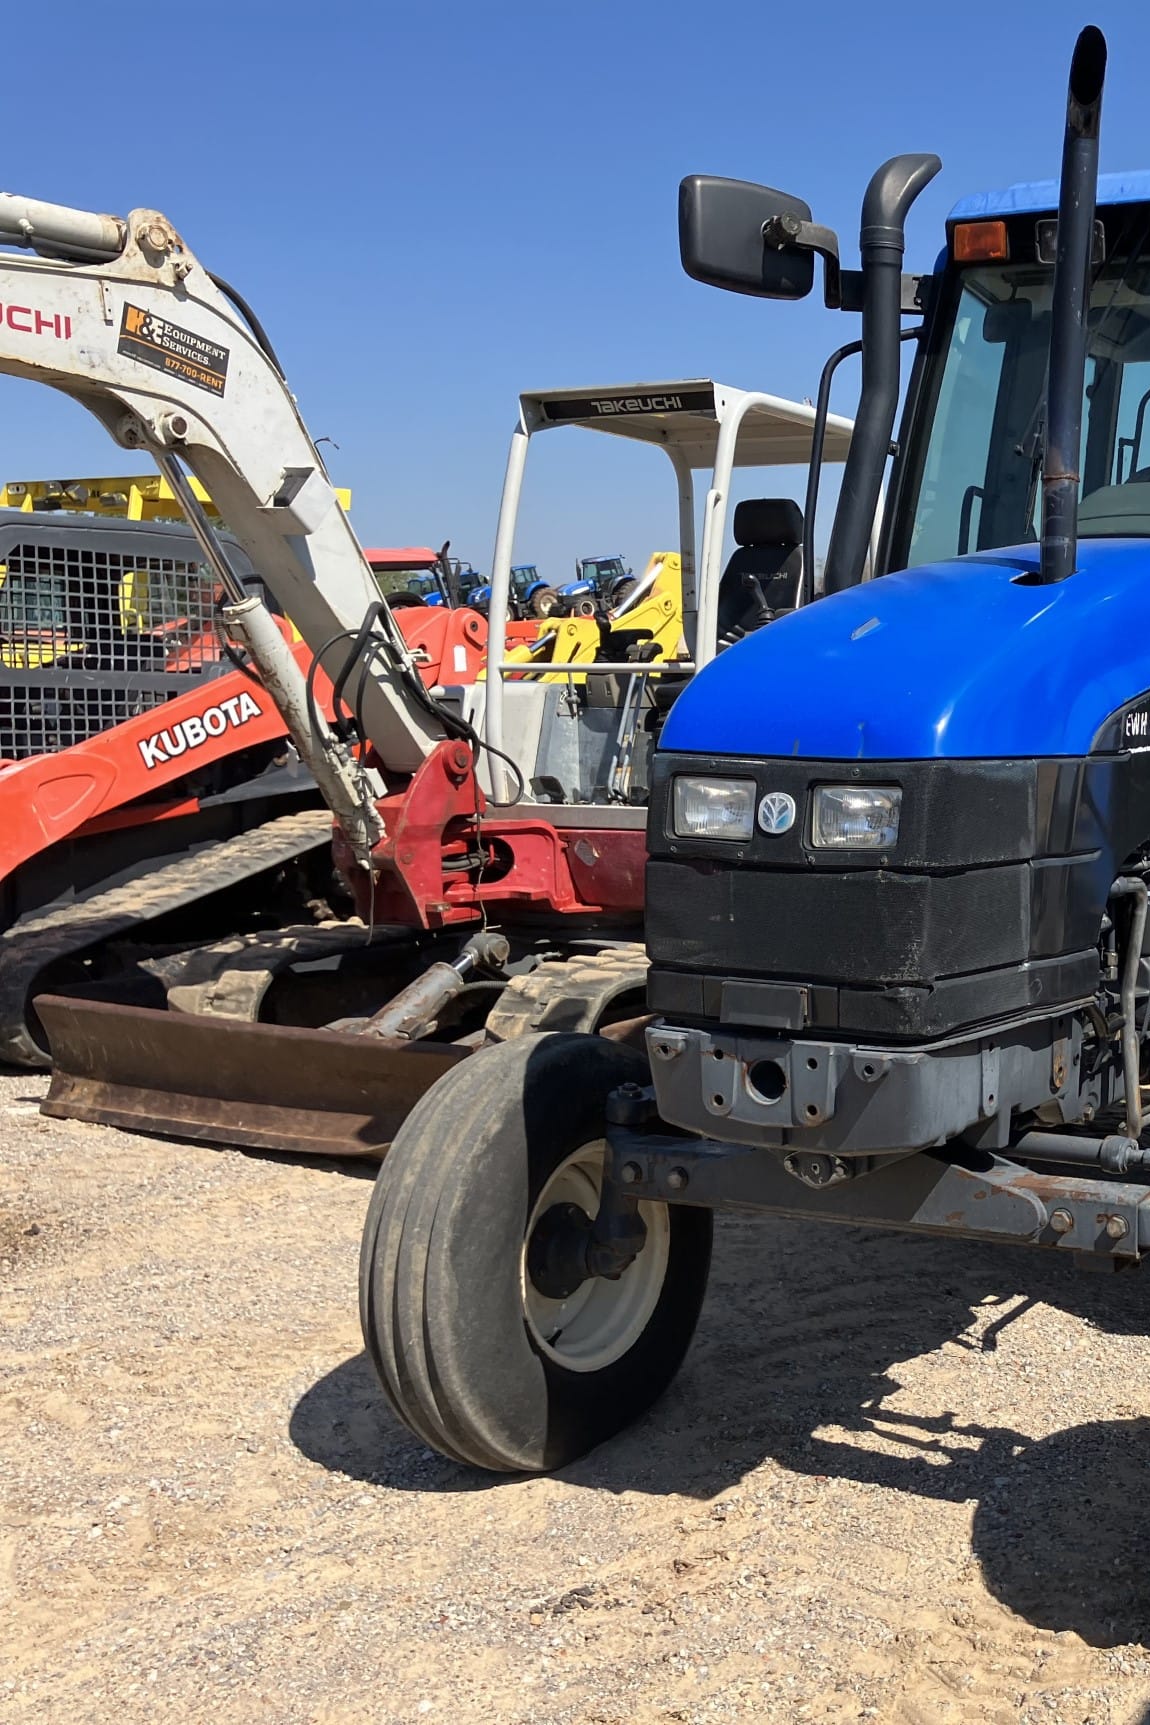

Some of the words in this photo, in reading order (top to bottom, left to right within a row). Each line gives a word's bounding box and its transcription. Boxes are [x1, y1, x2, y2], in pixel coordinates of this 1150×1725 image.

[0, 302, 71, 340] CHI
[162, 336, 210, 365] SERVICES
[164, 322, 226, 360] EQUIPMENT
[591, 396, 683, 414] TAKEUCHI
[138, 691, 263, 769] KUBOTA
